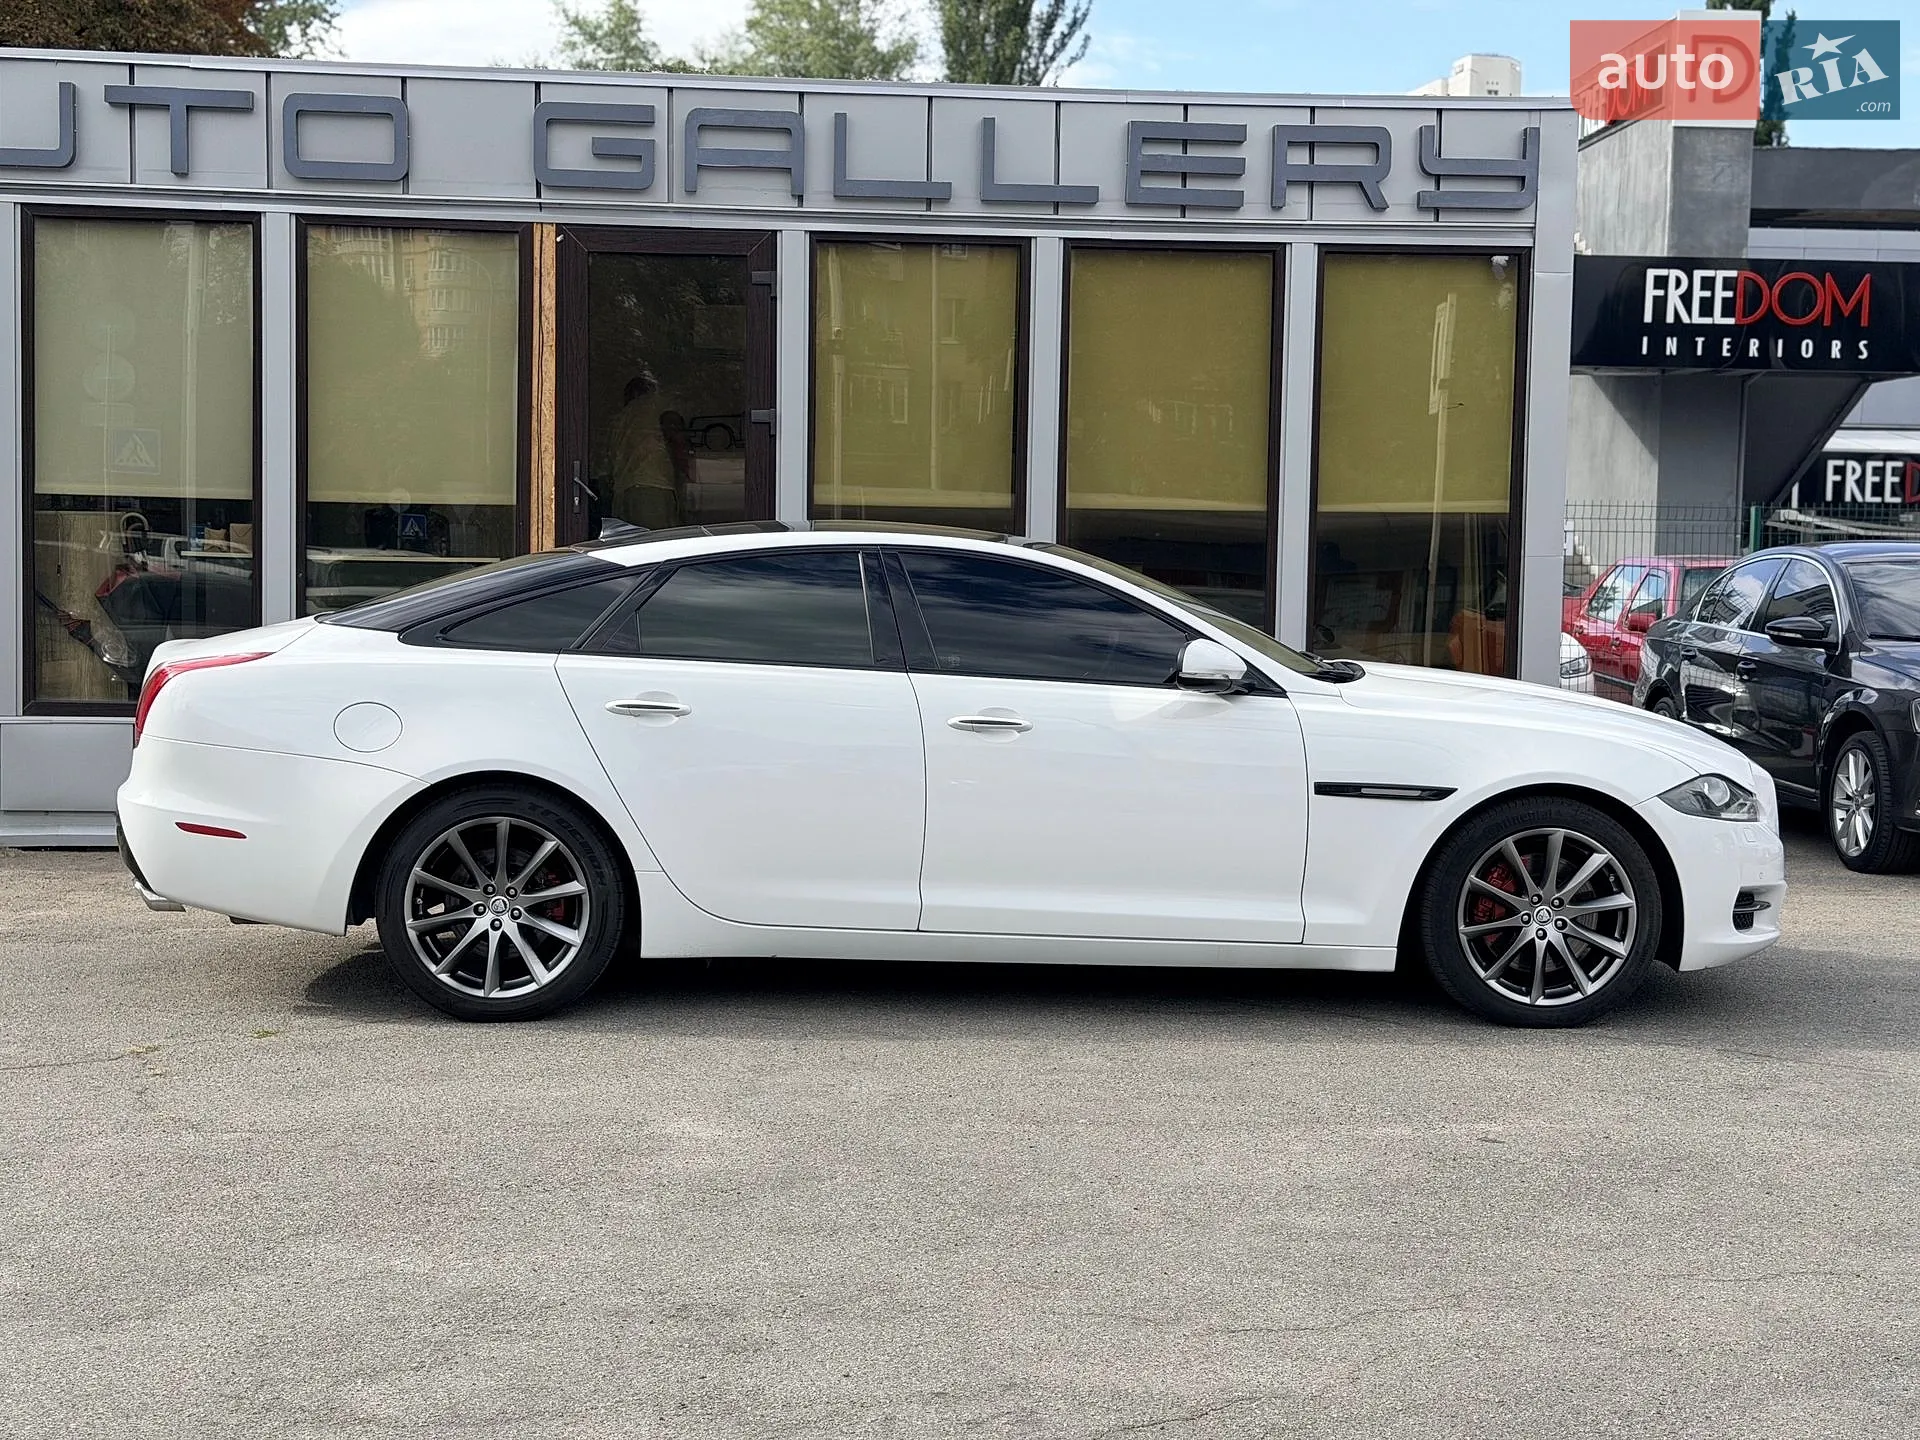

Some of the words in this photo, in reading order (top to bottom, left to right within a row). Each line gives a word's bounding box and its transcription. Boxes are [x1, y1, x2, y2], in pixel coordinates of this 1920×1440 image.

[535, 100, 1540, 210] GALLERY
[1643, 268, 1871, 327] FREEDOM
[1641, 336, 1869, 359] INTERIORS
